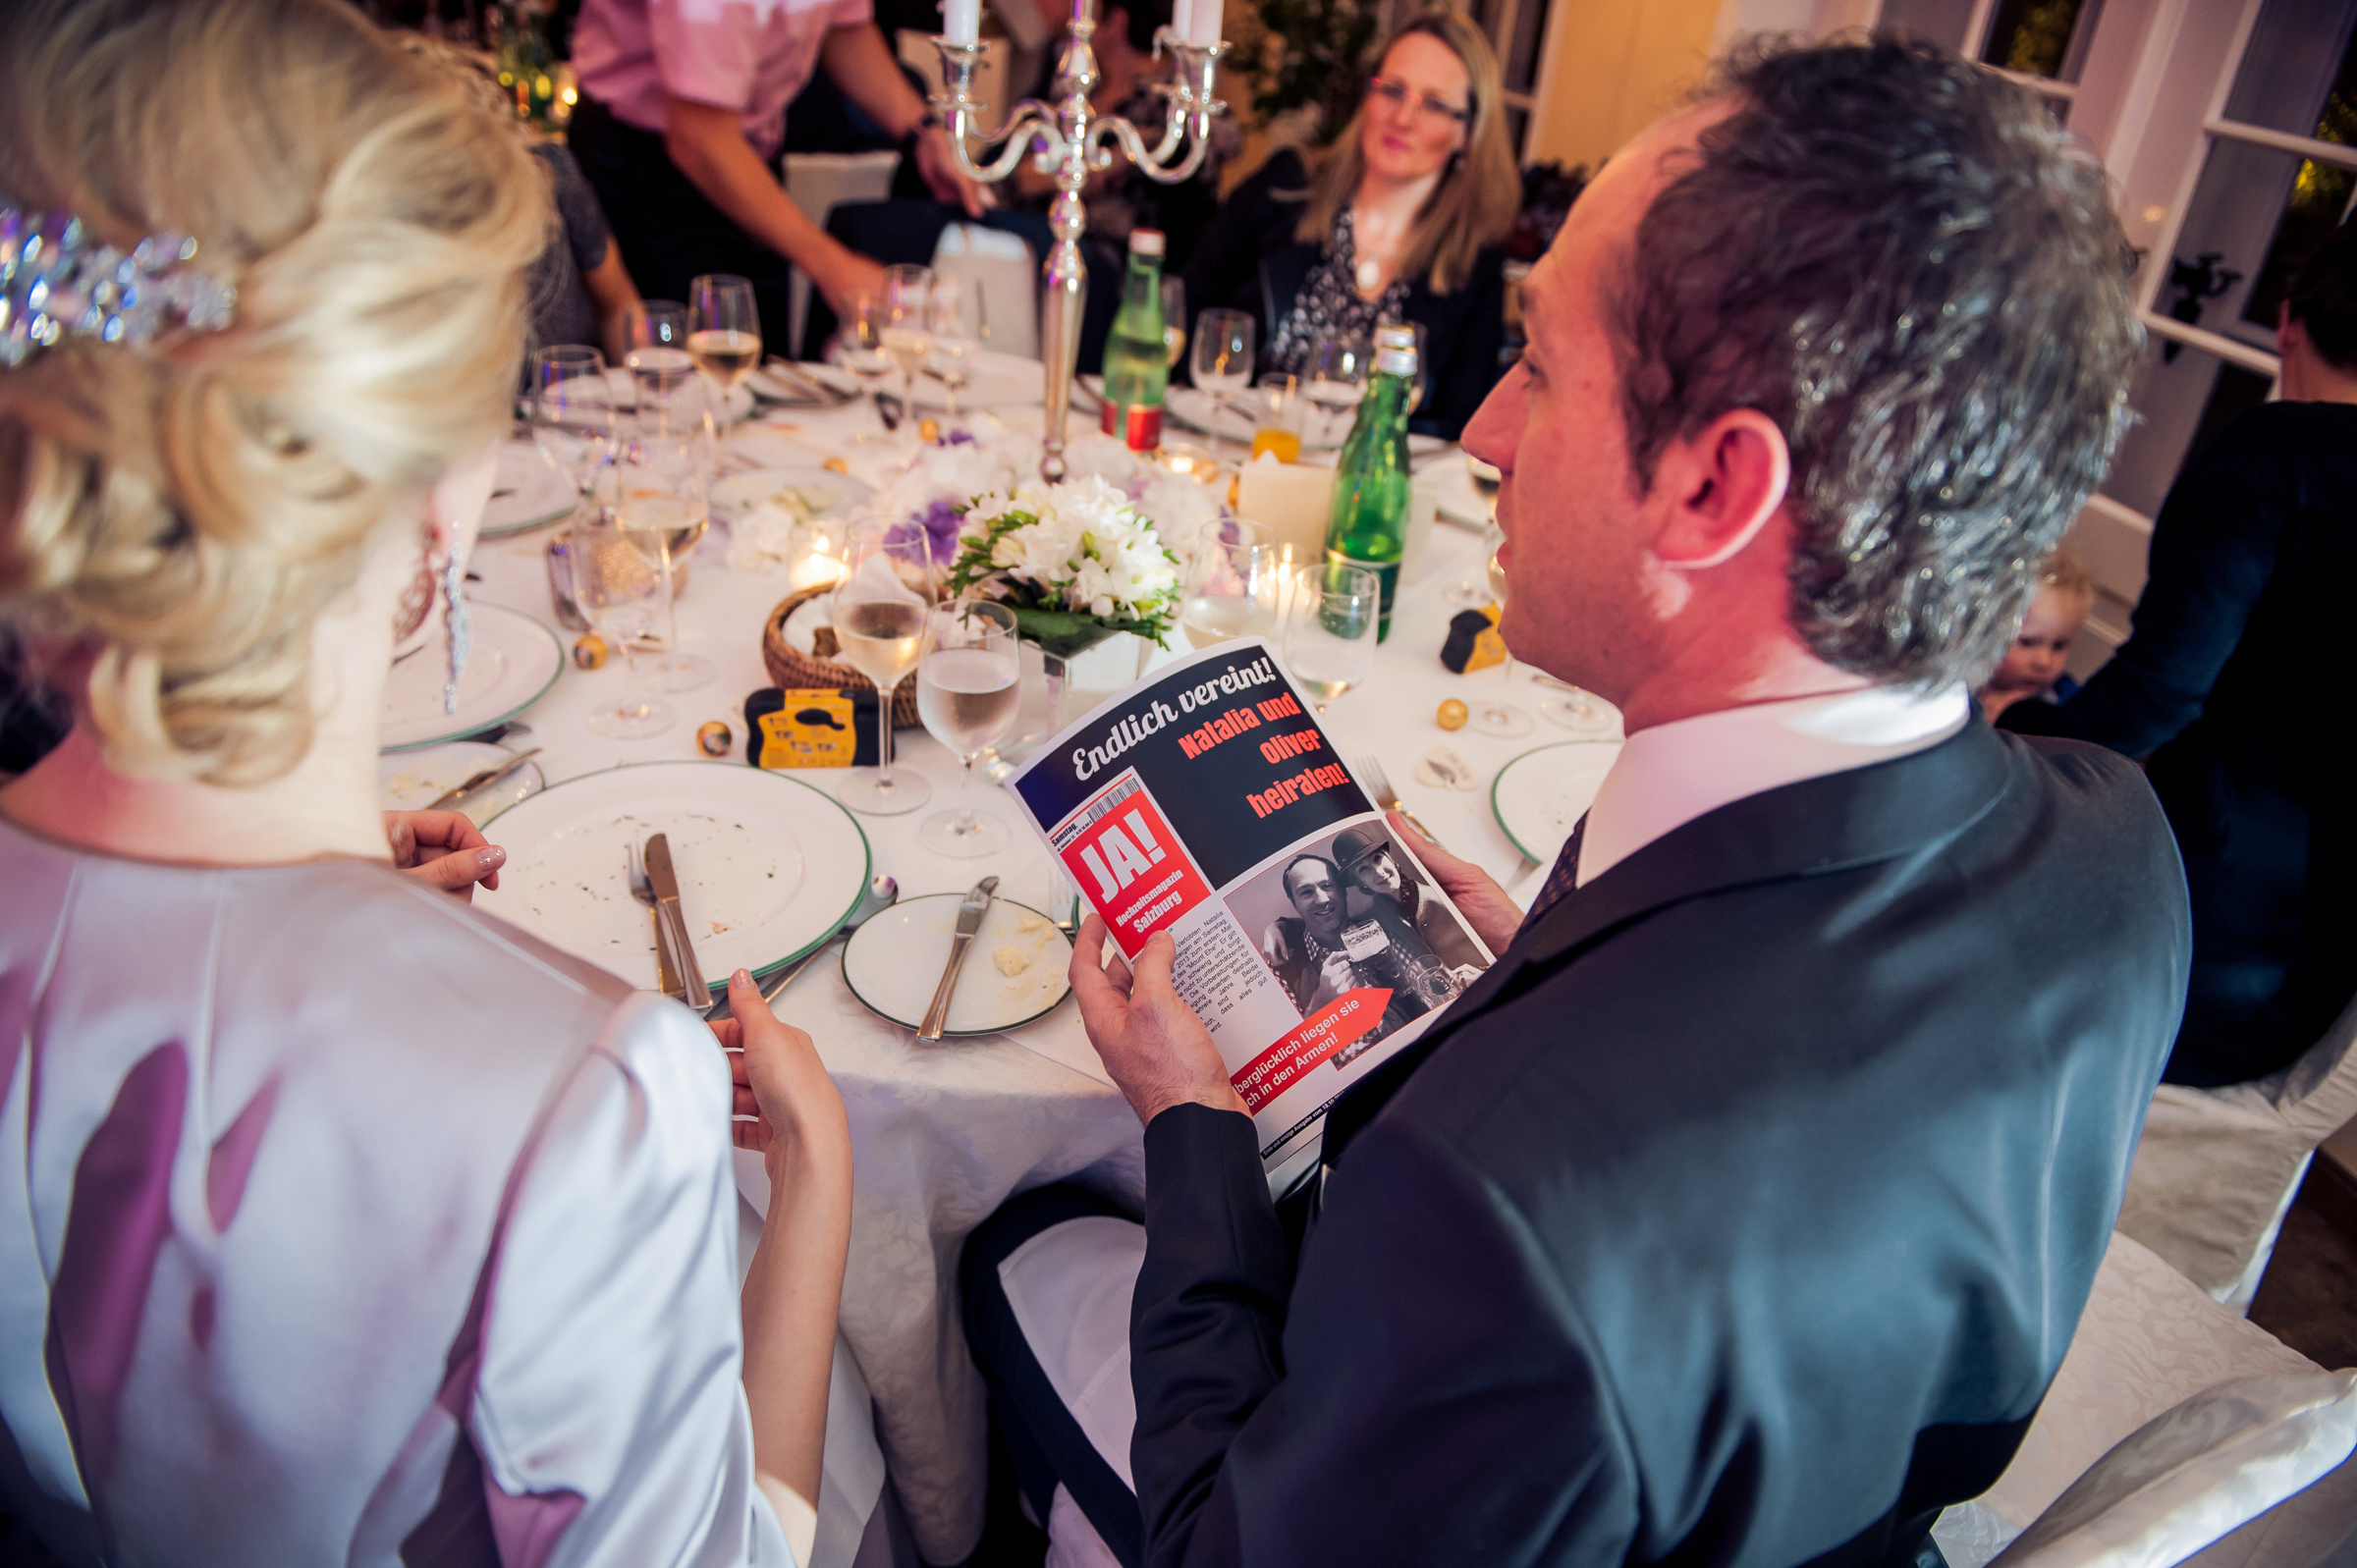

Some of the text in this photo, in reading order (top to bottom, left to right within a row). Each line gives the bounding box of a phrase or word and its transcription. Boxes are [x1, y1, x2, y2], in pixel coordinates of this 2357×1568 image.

[1072, 657, 1277, 781] Endlich vereint!
[1178, 691, 1301, 760] Natalia und
[1246, 763, 1349, 819] heiraten!
[1080, 808, 1167, 903] JA!
[1116, 870, 1183, 927] Hochzeitsmagazin
[1133, 891, 1182, 933] Salzburg
[1177, 911, 1224, 947] Verlobten Natalia
[1177, 923, 1233, 968] 2013 zum ersten Mal
[1188, 958, 1212, 980] schwierig
[1214, 948, 1225, 959] und
[1228, 937, 1241, 948] birgt
[1189, 949, 1249, 999] Die Vorbereitungen für
[1208, 975, 1231, 994] dauerten
[1232, 957, 1254, 975] deshalb
[1241, 964, 1258, 978] Beide
[1183, 981, 1196, 994] nicht
[1218, 970, 1263, 1007] sind jedoch
[1221, 1002, 1233, 1014] dass
[1238, 988, 1252, 1000] alles
[1257, 976, 1268, 987] gut
[1233, 1000, 1359, 1094] berglücklich liegen sie
[1246, 1031, 1339, 1107] ch in den Armen!
[1281, 1129, 1294, 1142] einzige
[1294, 1115, 1312, 1131] Ausgabe
[1312, 1108, 1322, 1117] vom
